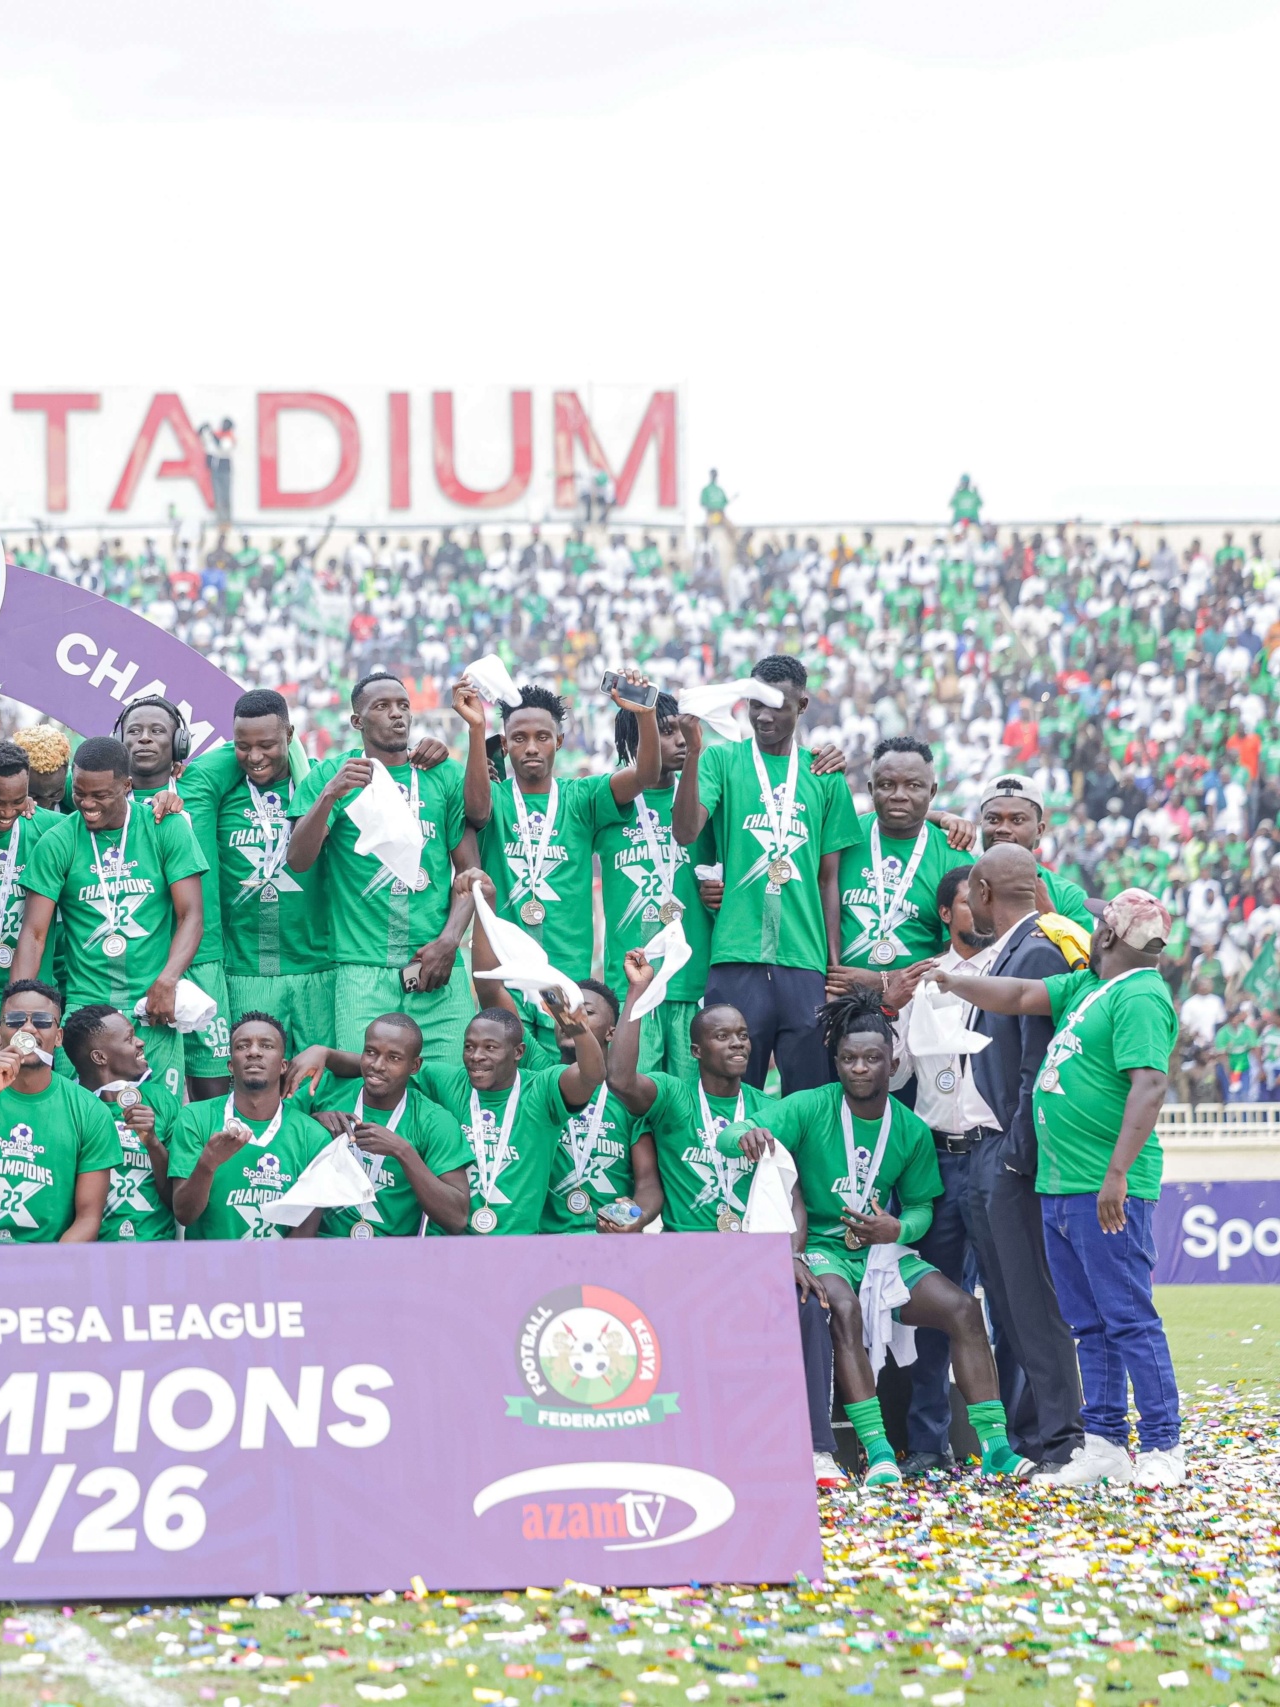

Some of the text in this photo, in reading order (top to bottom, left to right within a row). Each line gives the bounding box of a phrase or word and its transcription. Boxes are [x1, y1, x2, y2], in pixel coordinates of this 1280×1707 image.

[641, 874, 663, 897] 22
[204, 1016, 231, 1047] 36
[243, 1166, 292, 1182] SportPesa
[0, 1189, 23, 1213] 22
[116, 1178, 136, 1198] 22
[1182, 1204, 1280, 1272] Spo
[121, 1301, 306, 1341] LEAGUE
[519, 1305, 554, 1397] FOOTBALL
[630, 1318, 656, 1381] KENYA
[537, 1406, 651, 1428] FEDERATION
